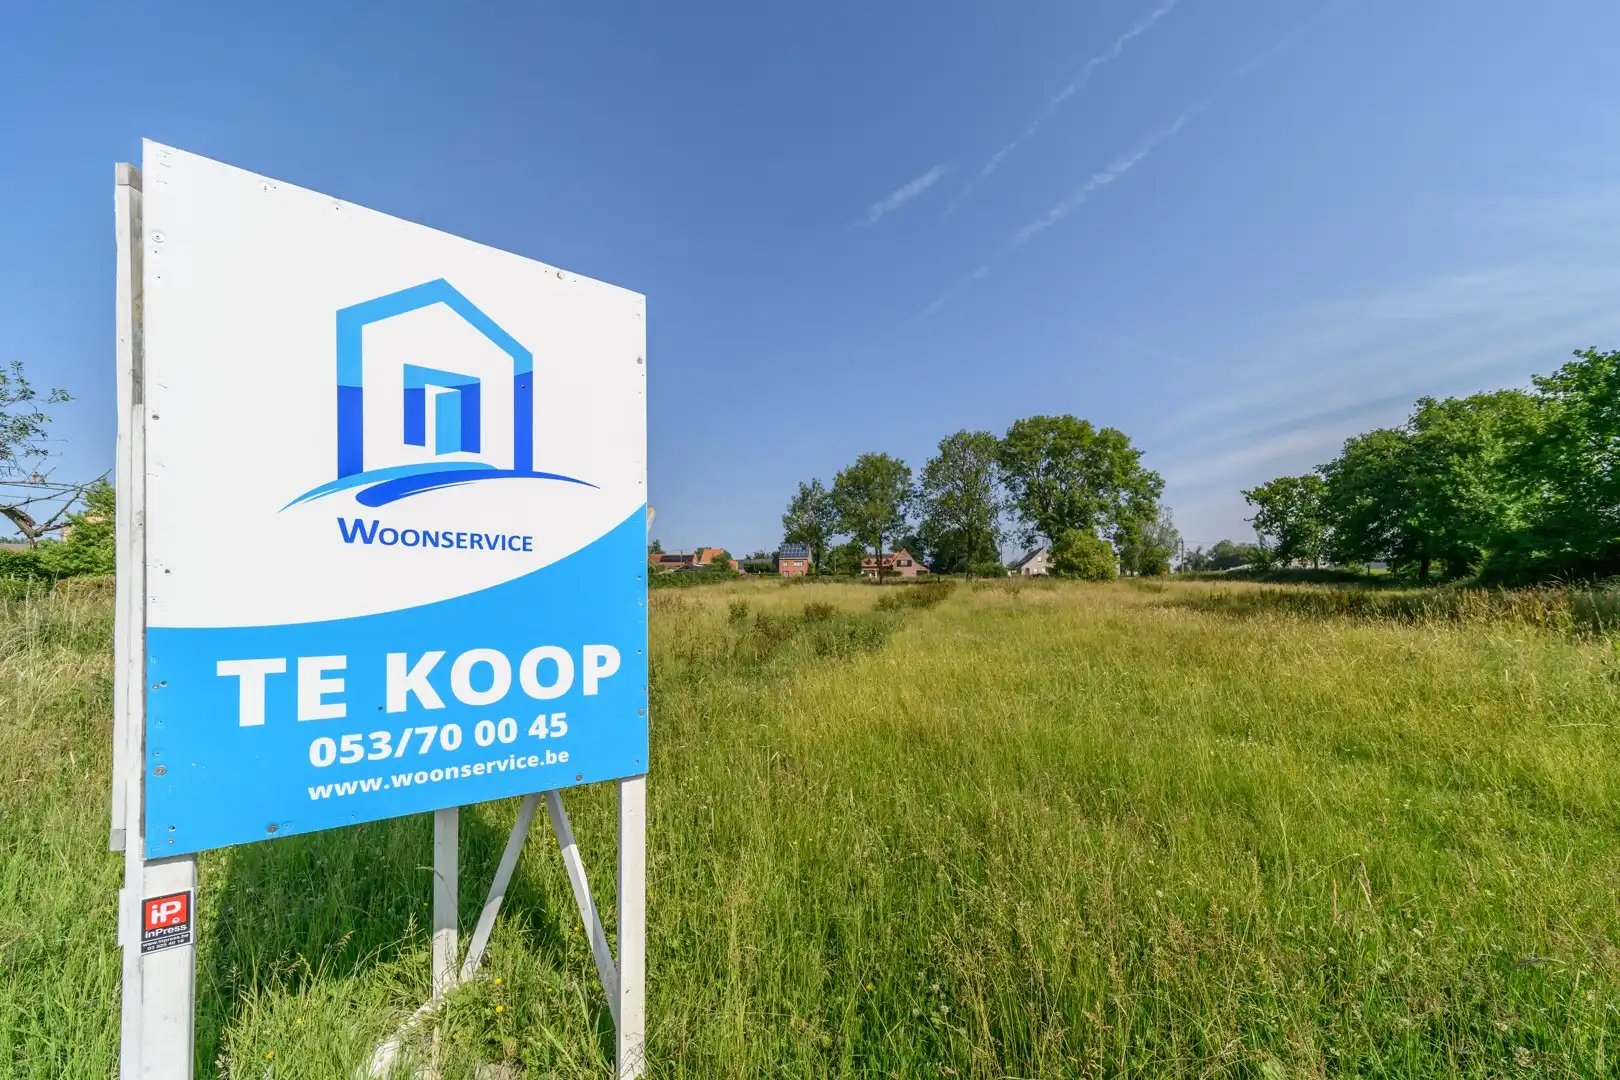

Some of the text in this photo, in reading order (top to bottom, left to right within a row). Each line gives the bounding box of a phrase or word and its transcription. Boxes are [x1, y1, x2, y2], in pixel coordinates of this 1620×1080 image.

[217, 644, 621, 727] TE KOOP
[309, 712, 568, 767] 053/70 00 45
[308, 749, 570, 800] www.woonservice.be
[145, 924, 187, 938] inPress
